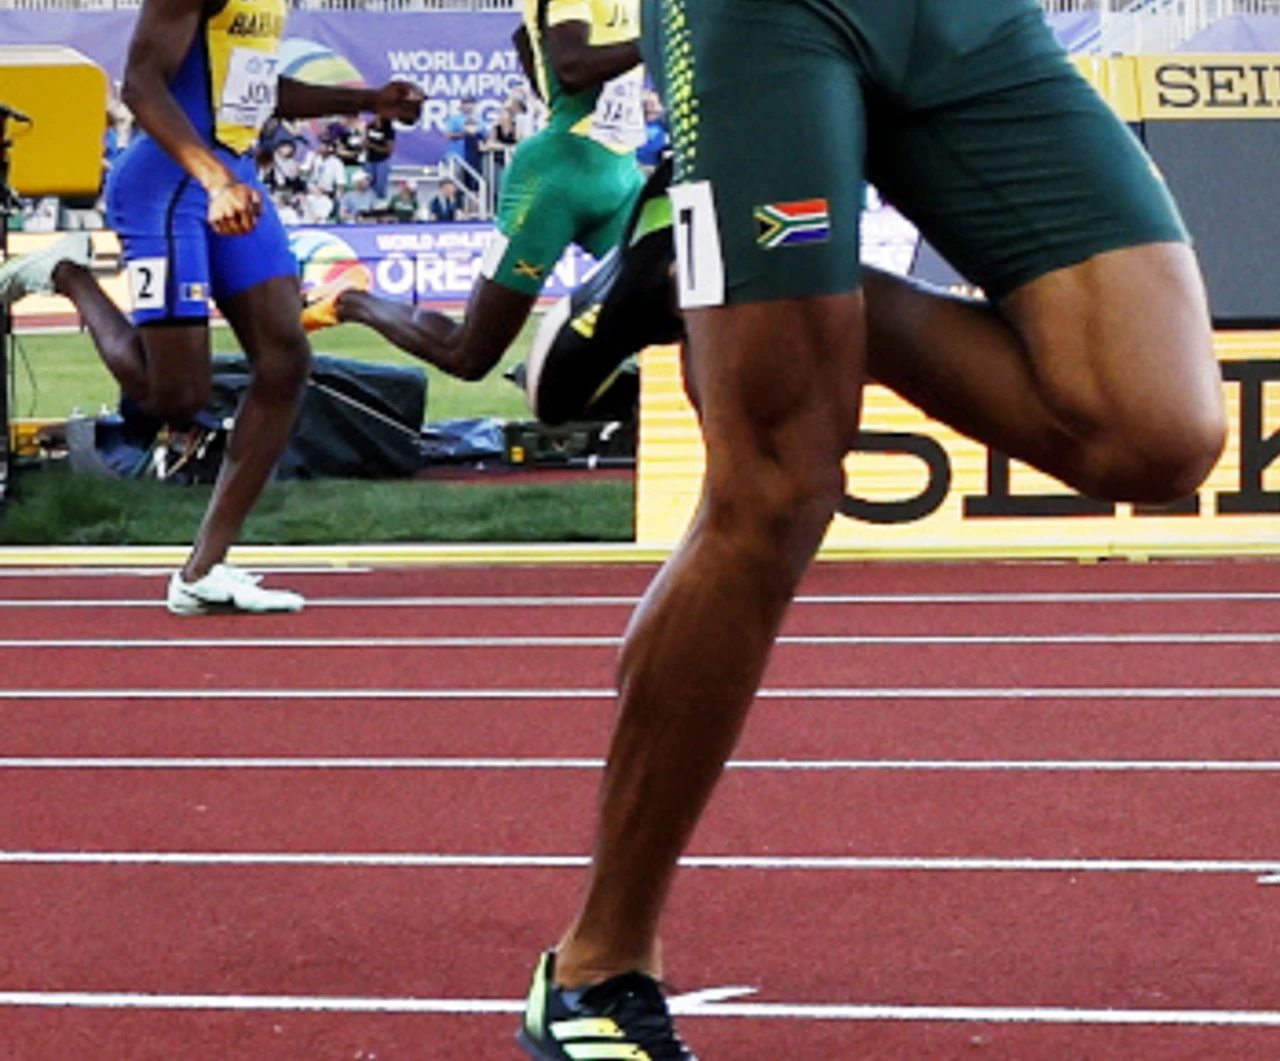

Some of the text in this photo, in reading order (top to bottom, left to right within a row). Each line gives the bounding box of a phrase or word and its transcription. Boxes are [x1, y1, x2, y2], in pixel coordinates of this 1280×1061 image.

[387, 50, 523, 72] WORLD AT
[390, 72, 532, 97] HAMPIO
[138, 267, 153, 299] 2
